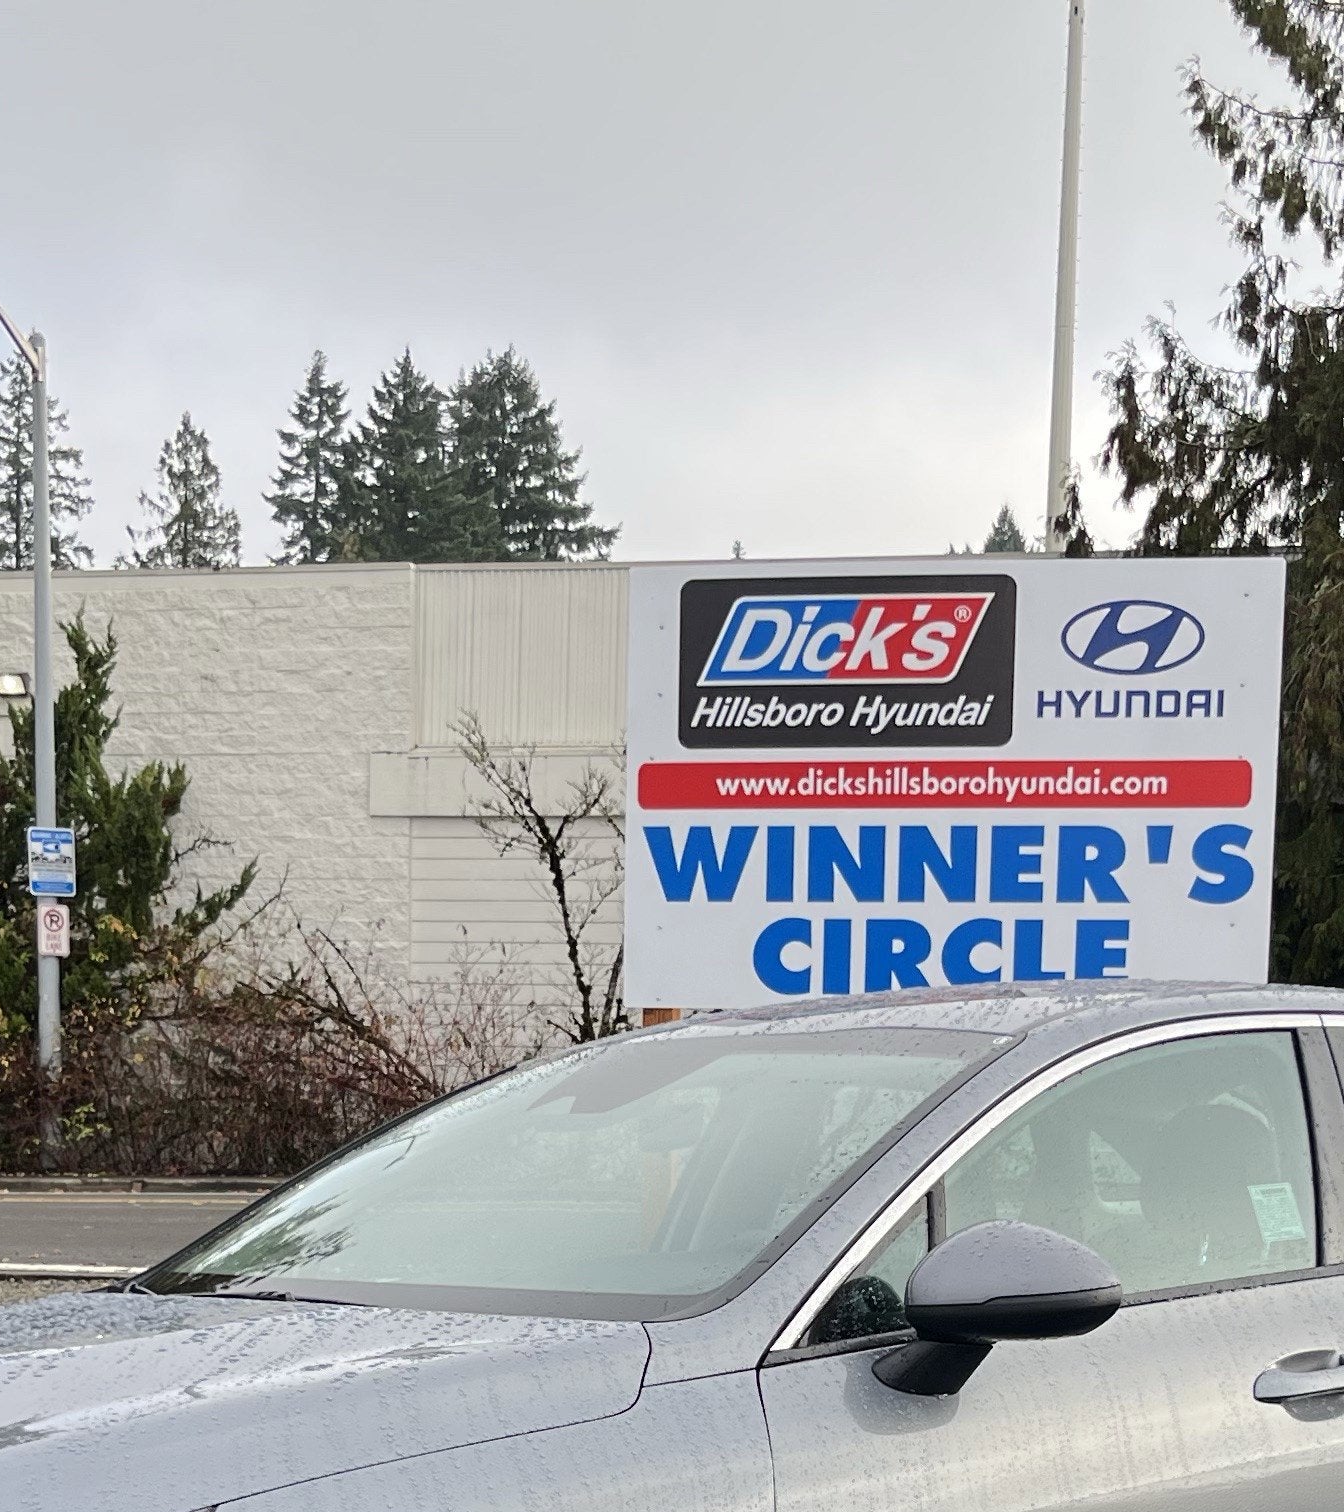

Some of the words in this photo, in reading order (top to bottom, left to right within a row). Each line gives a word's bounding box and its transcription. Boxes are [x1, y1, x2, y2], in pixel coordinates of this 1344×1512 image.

[721, 604, 956, 672] Dick's
[690, 696, 845, 728] Hillsboro
[849, 695, 995, 735] Hyundai
[1037, 689, 1224, 718] HYUNDAI
[716, 767, 1168, 803] www.dickshillsborohyundai.com
[643, 823, 1254, 904] WINNER'S
[752, 916, 1130, 995] CIRCLE
